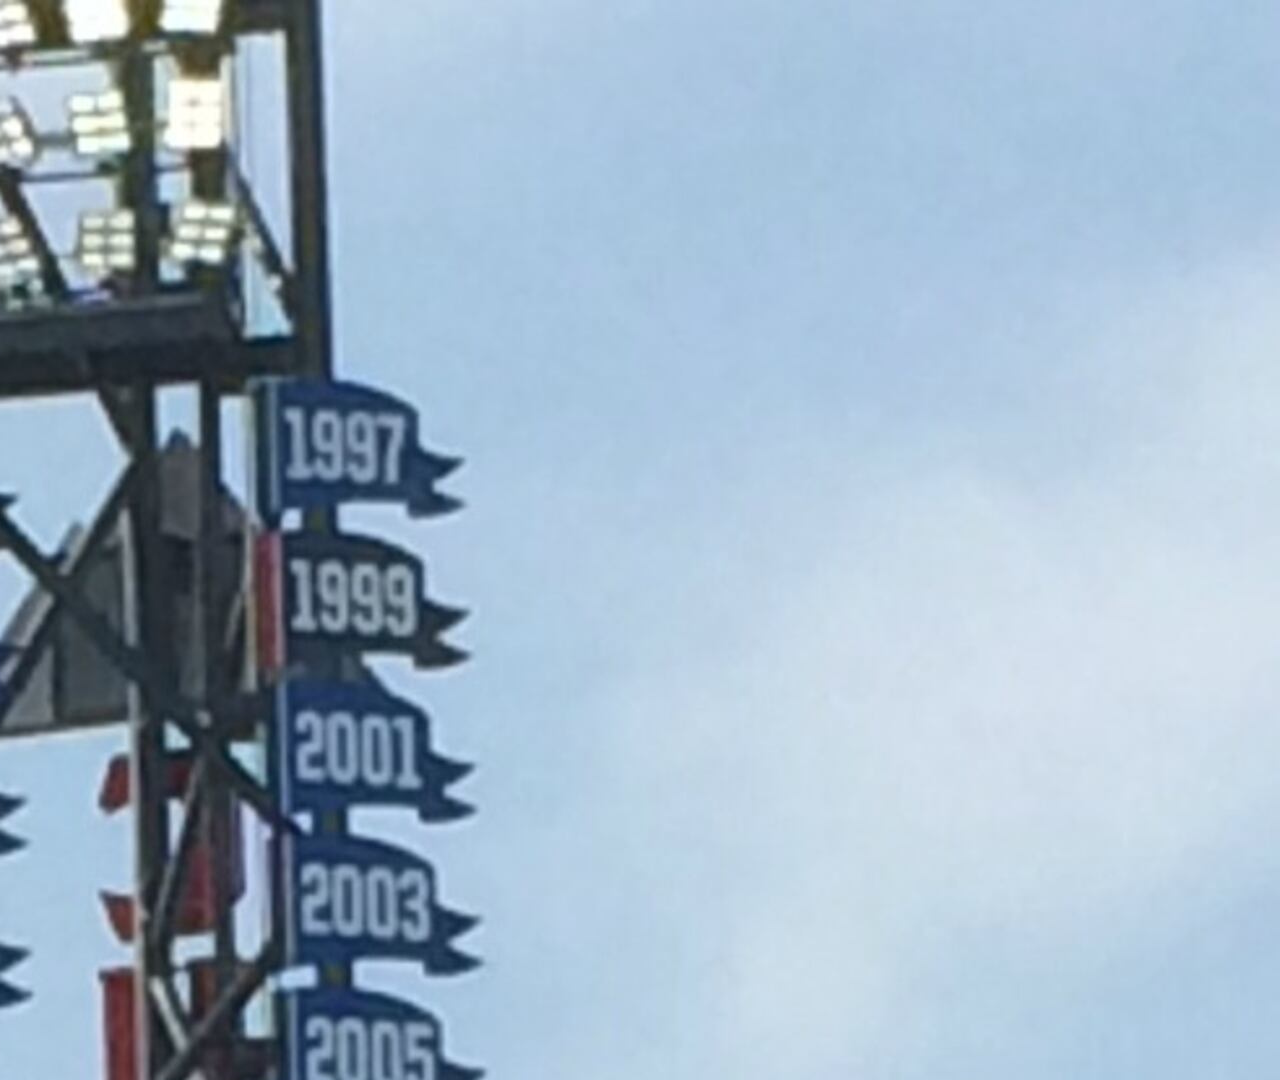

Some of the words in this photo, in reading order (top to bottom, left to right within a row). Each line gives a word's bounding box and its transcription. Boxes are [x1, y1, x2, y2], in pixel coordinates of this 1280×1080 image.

[285, 409, 407, 485] 1997
[292, 559, 417, 635] 1999
[296, 711, 422, 788] 2001
[301, 864, 431, 941] 2003
